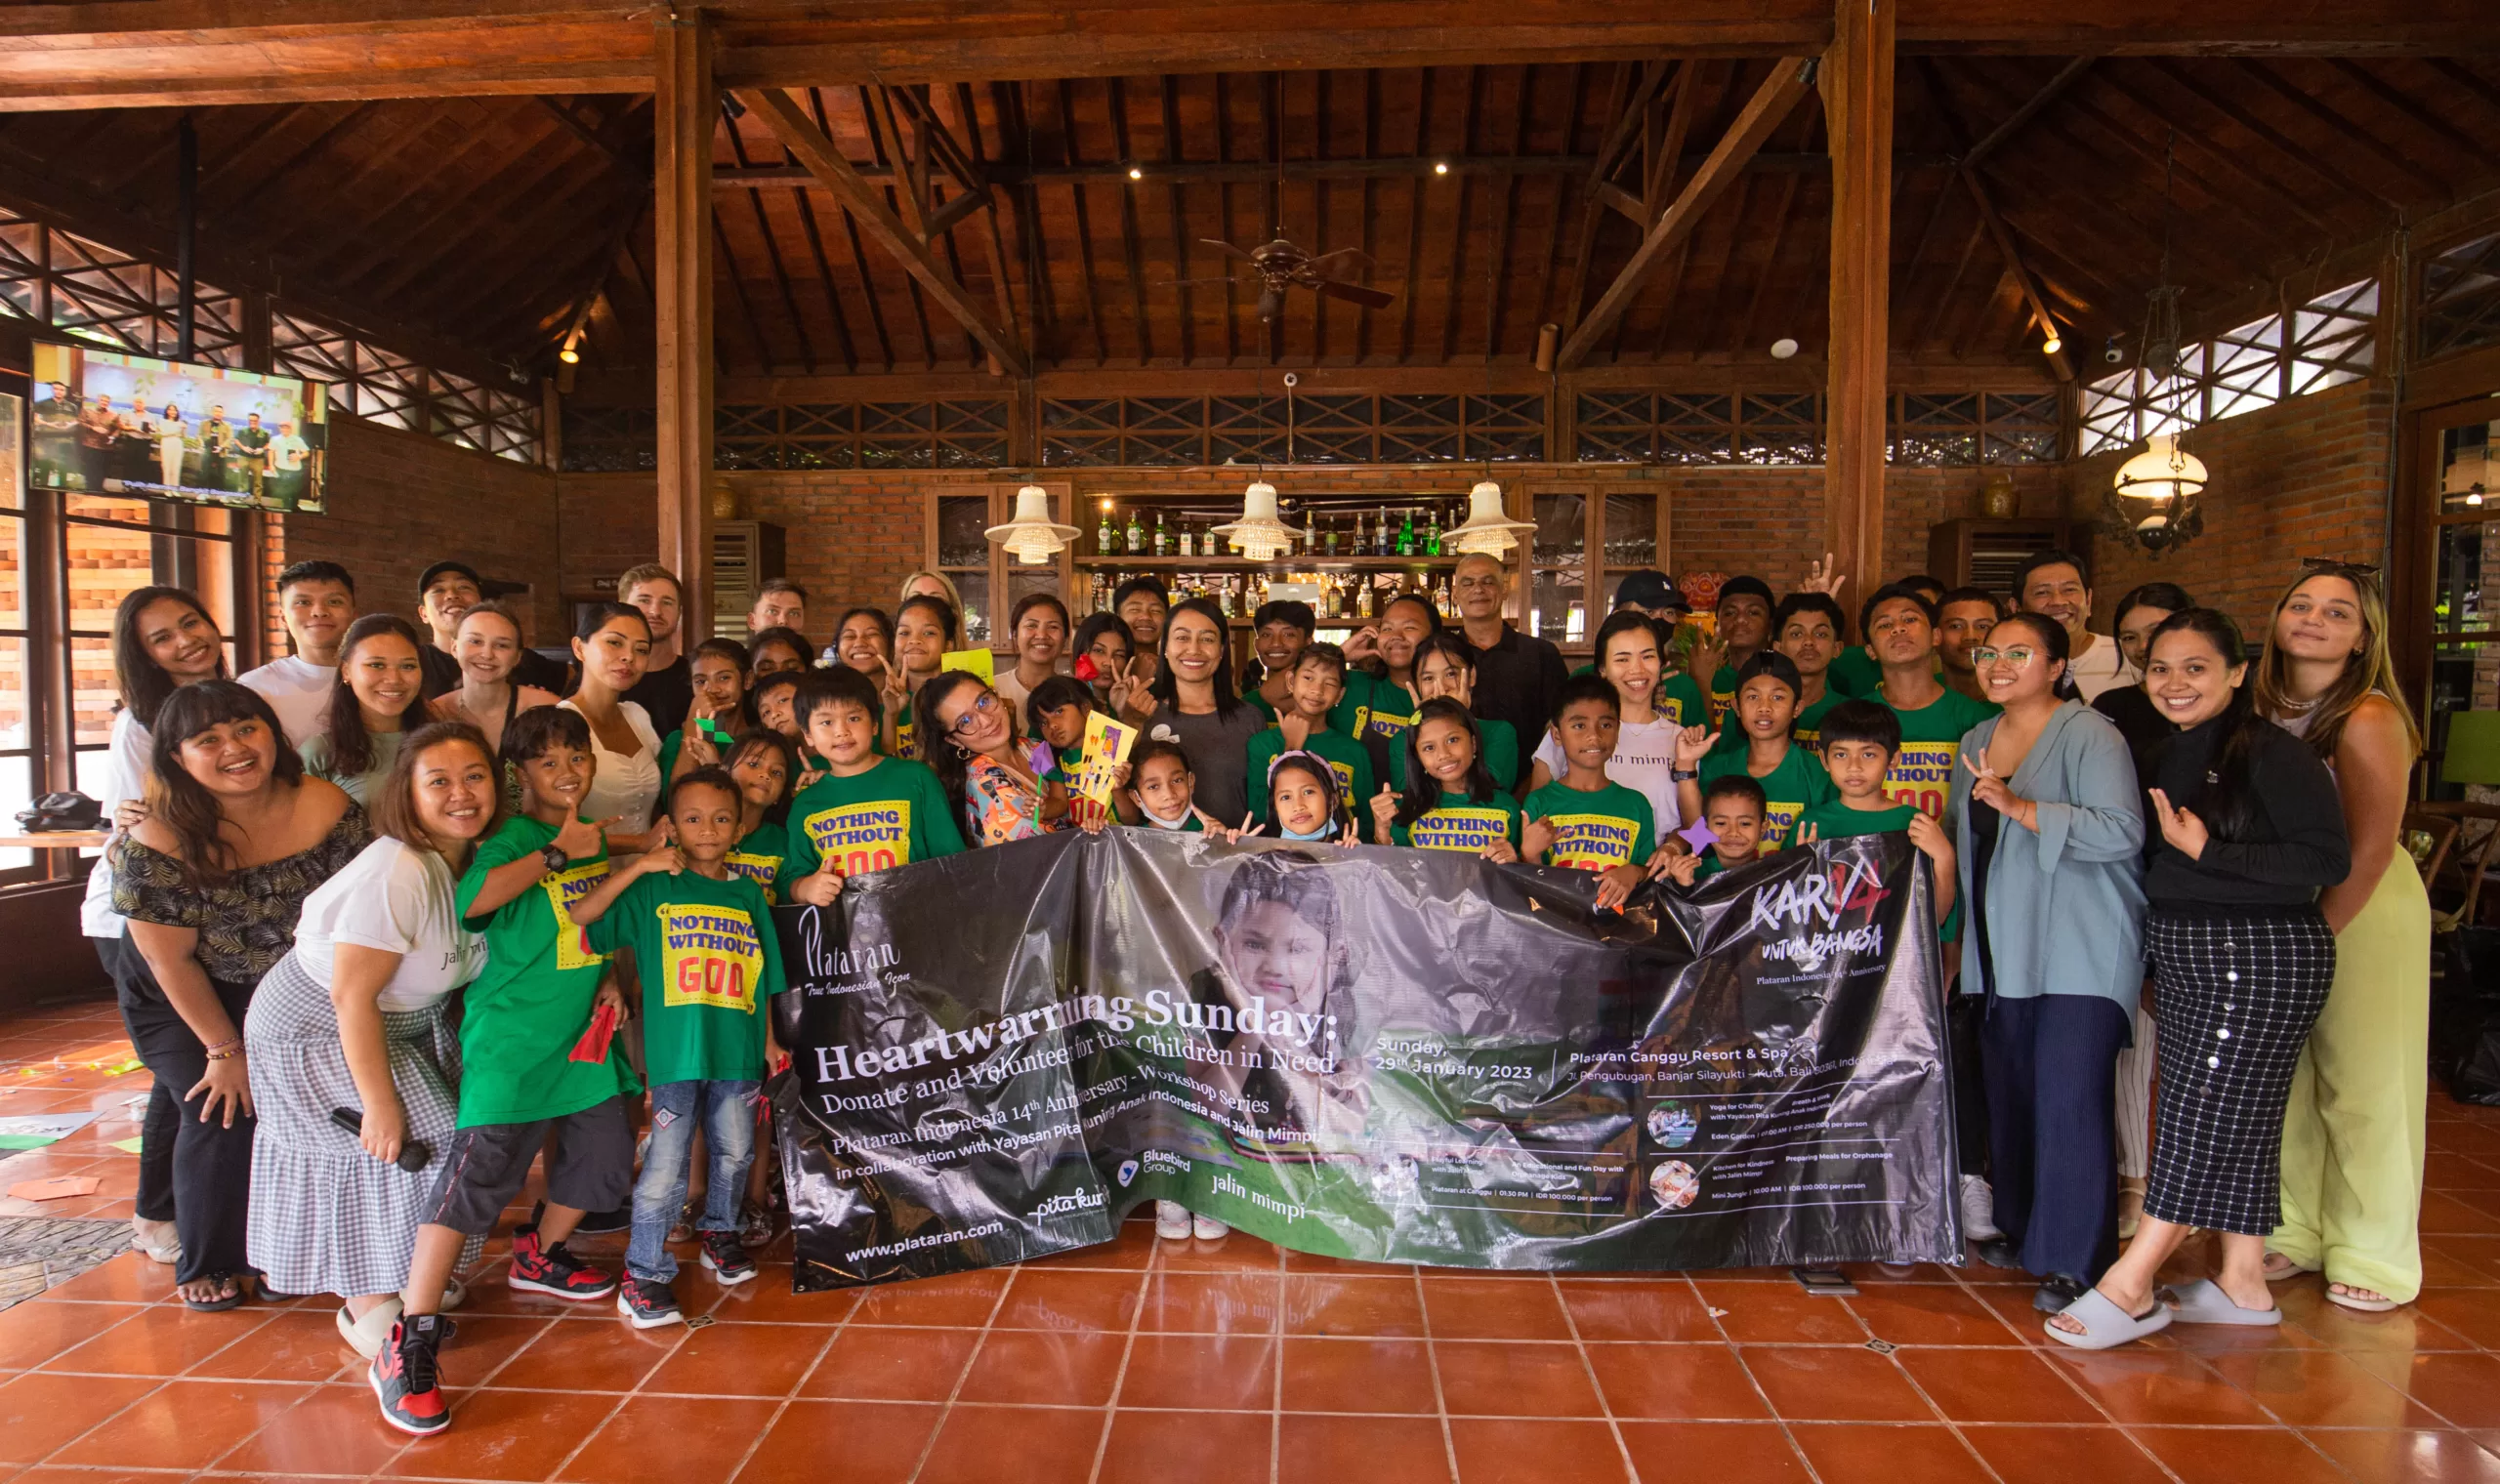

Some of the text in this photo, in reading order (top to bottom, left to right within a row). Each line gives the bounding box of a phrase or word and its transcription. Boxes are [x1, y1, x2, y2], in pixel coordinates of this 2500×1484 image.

[812, 810, 899, 835] NOTHING
[1416, 816, 1505, 834] NOTHING
[815, 827, 903, 851] WITHOUT
[669, 915, 758, 939] NOTHING
[667, 932, 760, 958] WITHOUT
[798, 905, 900, 977] Plataran
[1762, 924, 1884, 961] UNTUK BANGSA
[678, 956, 744, 998] GOD
[805, 971, 911, 997] True Indonesian Icon
[1756, 973, 1791, 985] Plataran
[1792, 971, 1831, 983] Indonesia
[1849, 964, 1887, 977] Anniversary
[813, 985, 1338, 1084] Heartwarming Sunday:
[1376, 1038, 1448, 1057] Sunday,
[1569, 1048, 1789, 1064] Plataran Canggu Resort & Spa
[820, 1029, 1336, 1114] Donate and Volunteer for the Children in Need
[1375, 1057, 1533, 1080] 29th January 2023
[1580, 1071, 1655, 1084] Pengubugan,
[1657, 1071, 1695, 1083] Banjar
[1696, 1070, 1745, 1082] Silayukti
[1758, 1068, 1787, 1080] Kuta,
[1789, 1066, 1812, 1077] Bali
[832, 1131, 913, 1156] Plataran
[912, 1108, 1009, 1142] Indonesia
[1010, 1099, 1041, 1122] 14th
[1044, 1073, 1129, 1114] Anniversary
[1137, 1063, 1218, 1102] Workshop
[1219, 1088, 1271, 1114] Series
[836, 1167, 853, 1181] in
[854, 1148, 957, 1177] collaboration
[958, 1139, 992, 1158] with
[993, 1129, 1053, 1151] Yayasan
[1054, 1123, 1082, 1139] Pita
[1116, 1092, 1147, 1114] Anak
[1147, 1090, 1208, 1116] Indonesia
[1209, 1108, 1230, 1128] and
[1231, 1120, 1265, 1139] Jalin
[1143, 1148, 1191, 1173] Bluebird
[1143, 1162, 1177, 1176] Group
[1593, 1165, 1607, 1174] Day
[1785, 1154, 1818, 1163] Preparing
[1466, 1188, 1492, 1197] Canggu
[1727, 1190, 1748, 1200] Jungle
[1252, 1190, 1306, 1224] mimpi
[845, 1220, 1005, 1263] www.plataran.com
